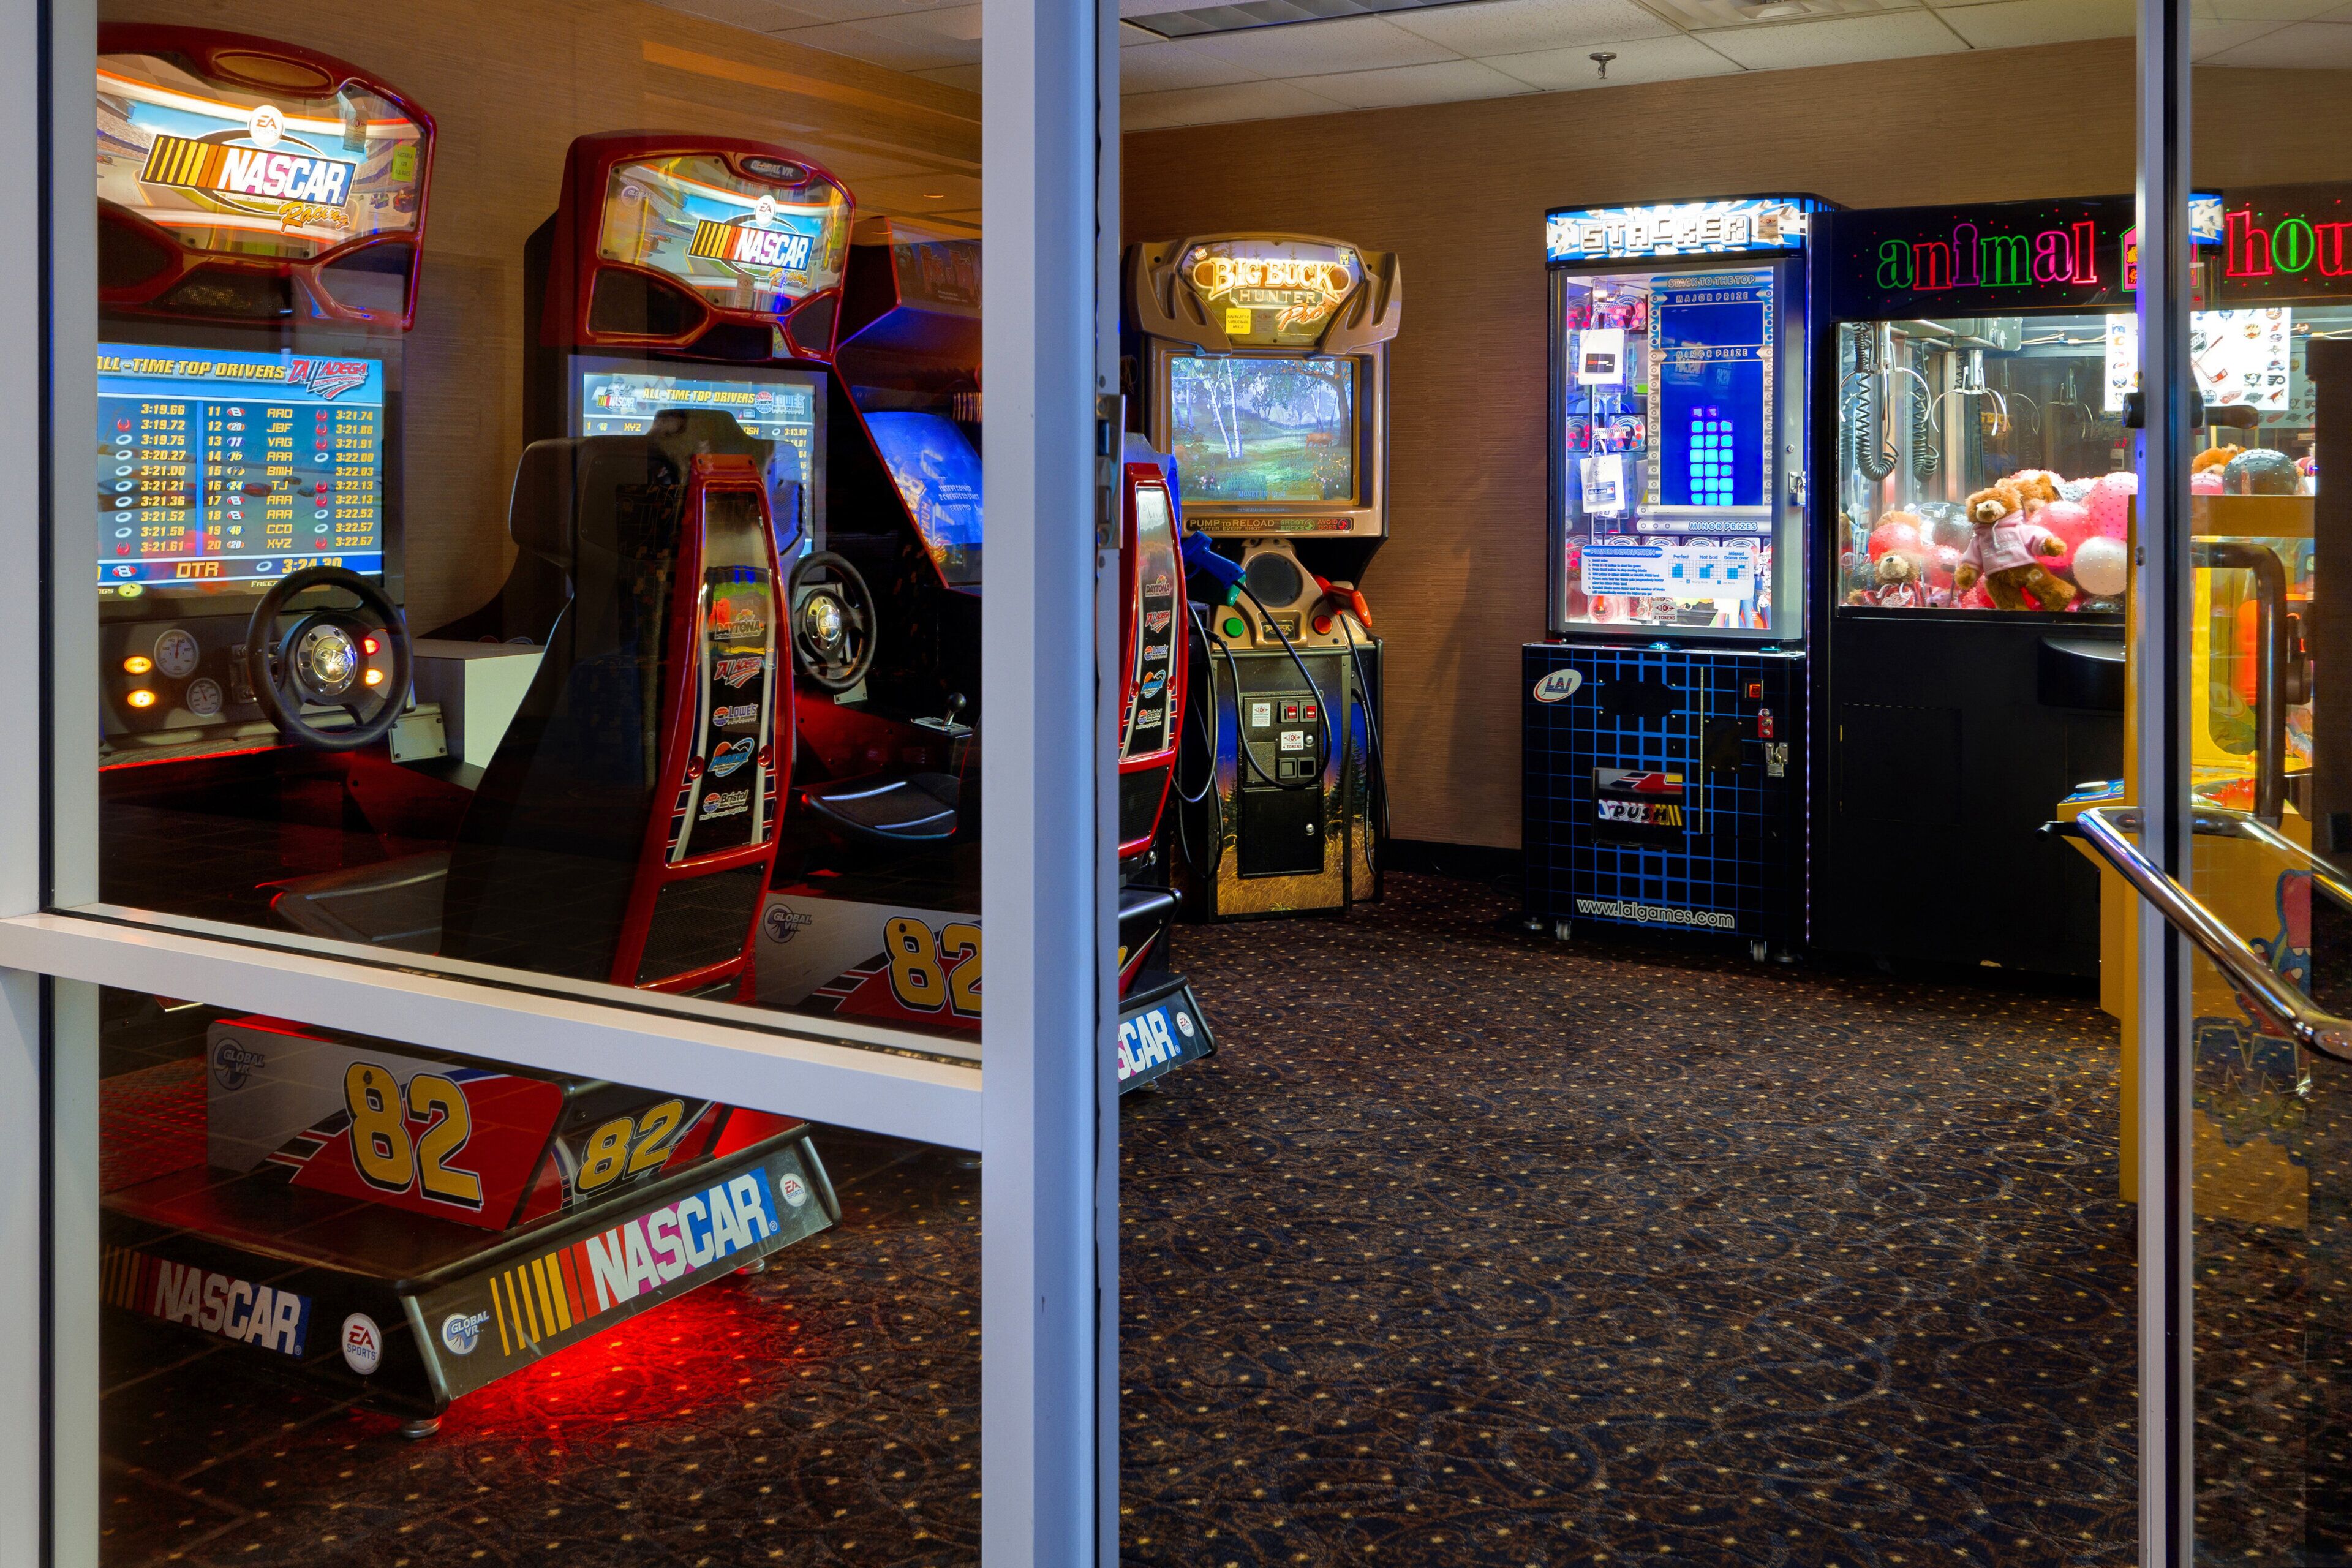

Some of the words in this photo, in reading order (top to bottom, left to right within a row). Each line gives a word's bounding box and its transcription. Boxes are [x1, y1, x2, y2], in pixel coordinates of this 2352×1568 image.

[750, 160, 780, 174] GLOBAL
[782, 166, 794, 176] VR
[217, 148, 346, 204] NASCAR
[279, 202, 349, 233] Racing
[1581, 214, 1747, 252] STACKER
[734, 228, 809, 268] NASCAR
[1877, 221, 2098, 290] animal
[1208, 258, 1262, 300] BIG
[1265, 258, 1340, 303] BUCK
[1668, 277, 1698, 288] STACK
[1700, 277, 1713, 286] TO
[1715, 276, 1733, 284] THE
[1735, 275, 1755, 284] TOP
[1239, 289, 1316, 304] HUNTER
[1676, 293, 1713, 303] MAJOR
[1716, 292, 1748, 301] PRIZE
[1275, 303, 1322, 331] Pro
[1676, 350, 1713, 358] MINOR
[1716, 349, 1748, 357] PRIZE
[178, 360, 211, 375] TOP
[214, 362, 286, 379] DRIVERS
[692, 390, 712, 402] TOP
[714, 392, 755, 404] DRIVERS
[208, 406, 222, 417] 11
[232, 407, 242, 417] 8
[336, 410, 373, 421] 3:21.74
[140, 419, 186, 430] 3:19.72
[208, 421, 222, 431] 12
[231, 421, 242, 431] 20
[267, 423, 293, 432] JBF
[624, 423, 641, 432] XYZ
[140, 434, 186, 445] 3:19.75
[208, 435, 222, 446] 13
[230, 437, 241, 447] 11
[140, 450, 186, 461] 3:20.27
[208, 451, 222, 461] 14
[230, 451, 243, 461] 16
[208, 466, 222, 476] 15
[140, 480, 186, 491] 3:21.21
[208, 480, 222, 491] 16
[229, 481, 243, 491] 24
[271, 481, 288, 491] TJ
[208, 495, 222, 505] 17
[232, 496, 241, 505] 8
[140, 511, 186, 522] 3:21.52
[208, 510, 222, 521] 18
[232, 510, 241, 520] 8
[208, 526, 222, 535] 19
[230, 526, 242, 535] 48
[336, 522, 374, 532] 3:22.57
[1688, 521, 1722, 531] MINOR
[1724, 521, 1758, 531] PRIZES
[140, 541, 186, 552] 3:21.61
[207, 540, 222, 550] 20
[231, 540, 241, 549] 20
[267, 538, 292, 548] XYZ
[117, 565, 132, 577] 8
[1545, 677, 1572, 693] LAI
[729, 703, 758, 718] LOWE'S
[721, 790, 748, 803] Bristol
[1613, 805, 1668, 822] PUSH
[773, 911, 813, 925] GLOBAL
[1576, 899, 1735, 929] www.laigames.com
[785, 921, 800, 932] VR
[883, 915, 982, 1019] 82
[1180, 1017, 1190, 1027] EA
[223, 1048, 265, 1067] GLOBAL
[343, 1060, 484, 1211] 82
[574, 1099, 685, 1194] 82
[783, 1180, 801, 1195] EA
[786, 1188, 805, 1200] SPORTS
[585, 1173, 772, 1312] NASCAR
[154, 1259, 301, 1355] NASCAR
[450, 1311, 490, 1335] GLOBAL
[464, 1324, 480, 1335] VR
[349, 1325, 375, 1350] EA
[347, 1344, 377, 1360] SPORTS
